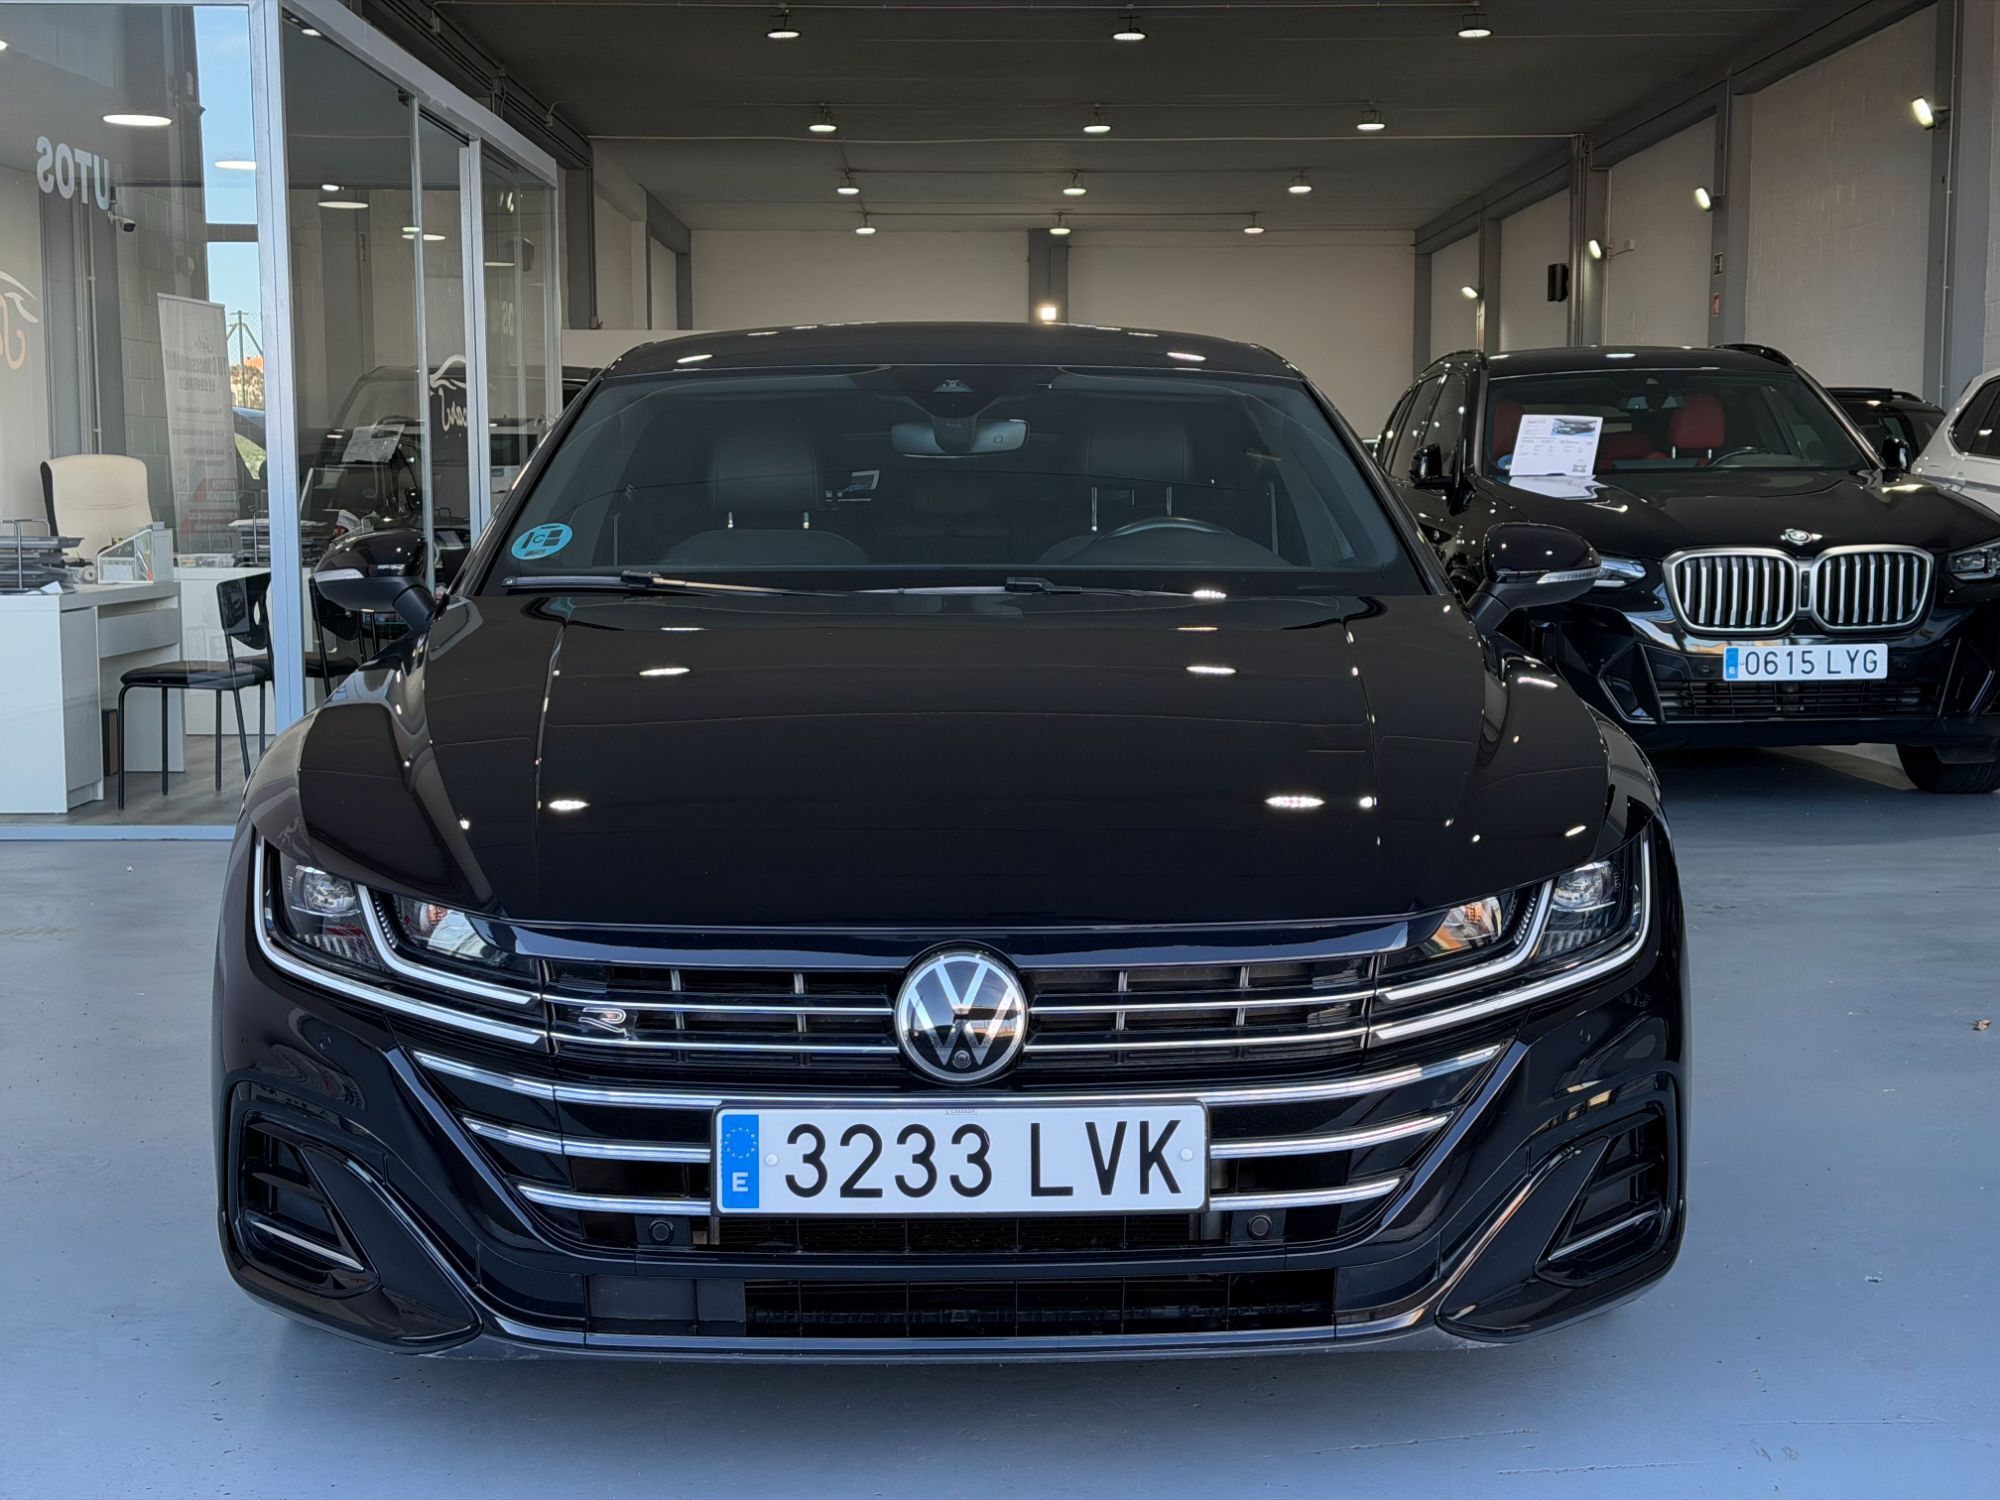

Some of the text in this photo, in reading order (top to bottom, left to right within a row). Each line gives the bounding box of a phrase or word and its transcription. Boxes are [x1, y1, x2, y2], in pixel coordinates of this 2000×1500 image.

[1745, 649, 1878, 675] 0615 LYG
[785, 1119, 1182, 1198] 3233 LVK
[732, 1172, 749, 1192] E
